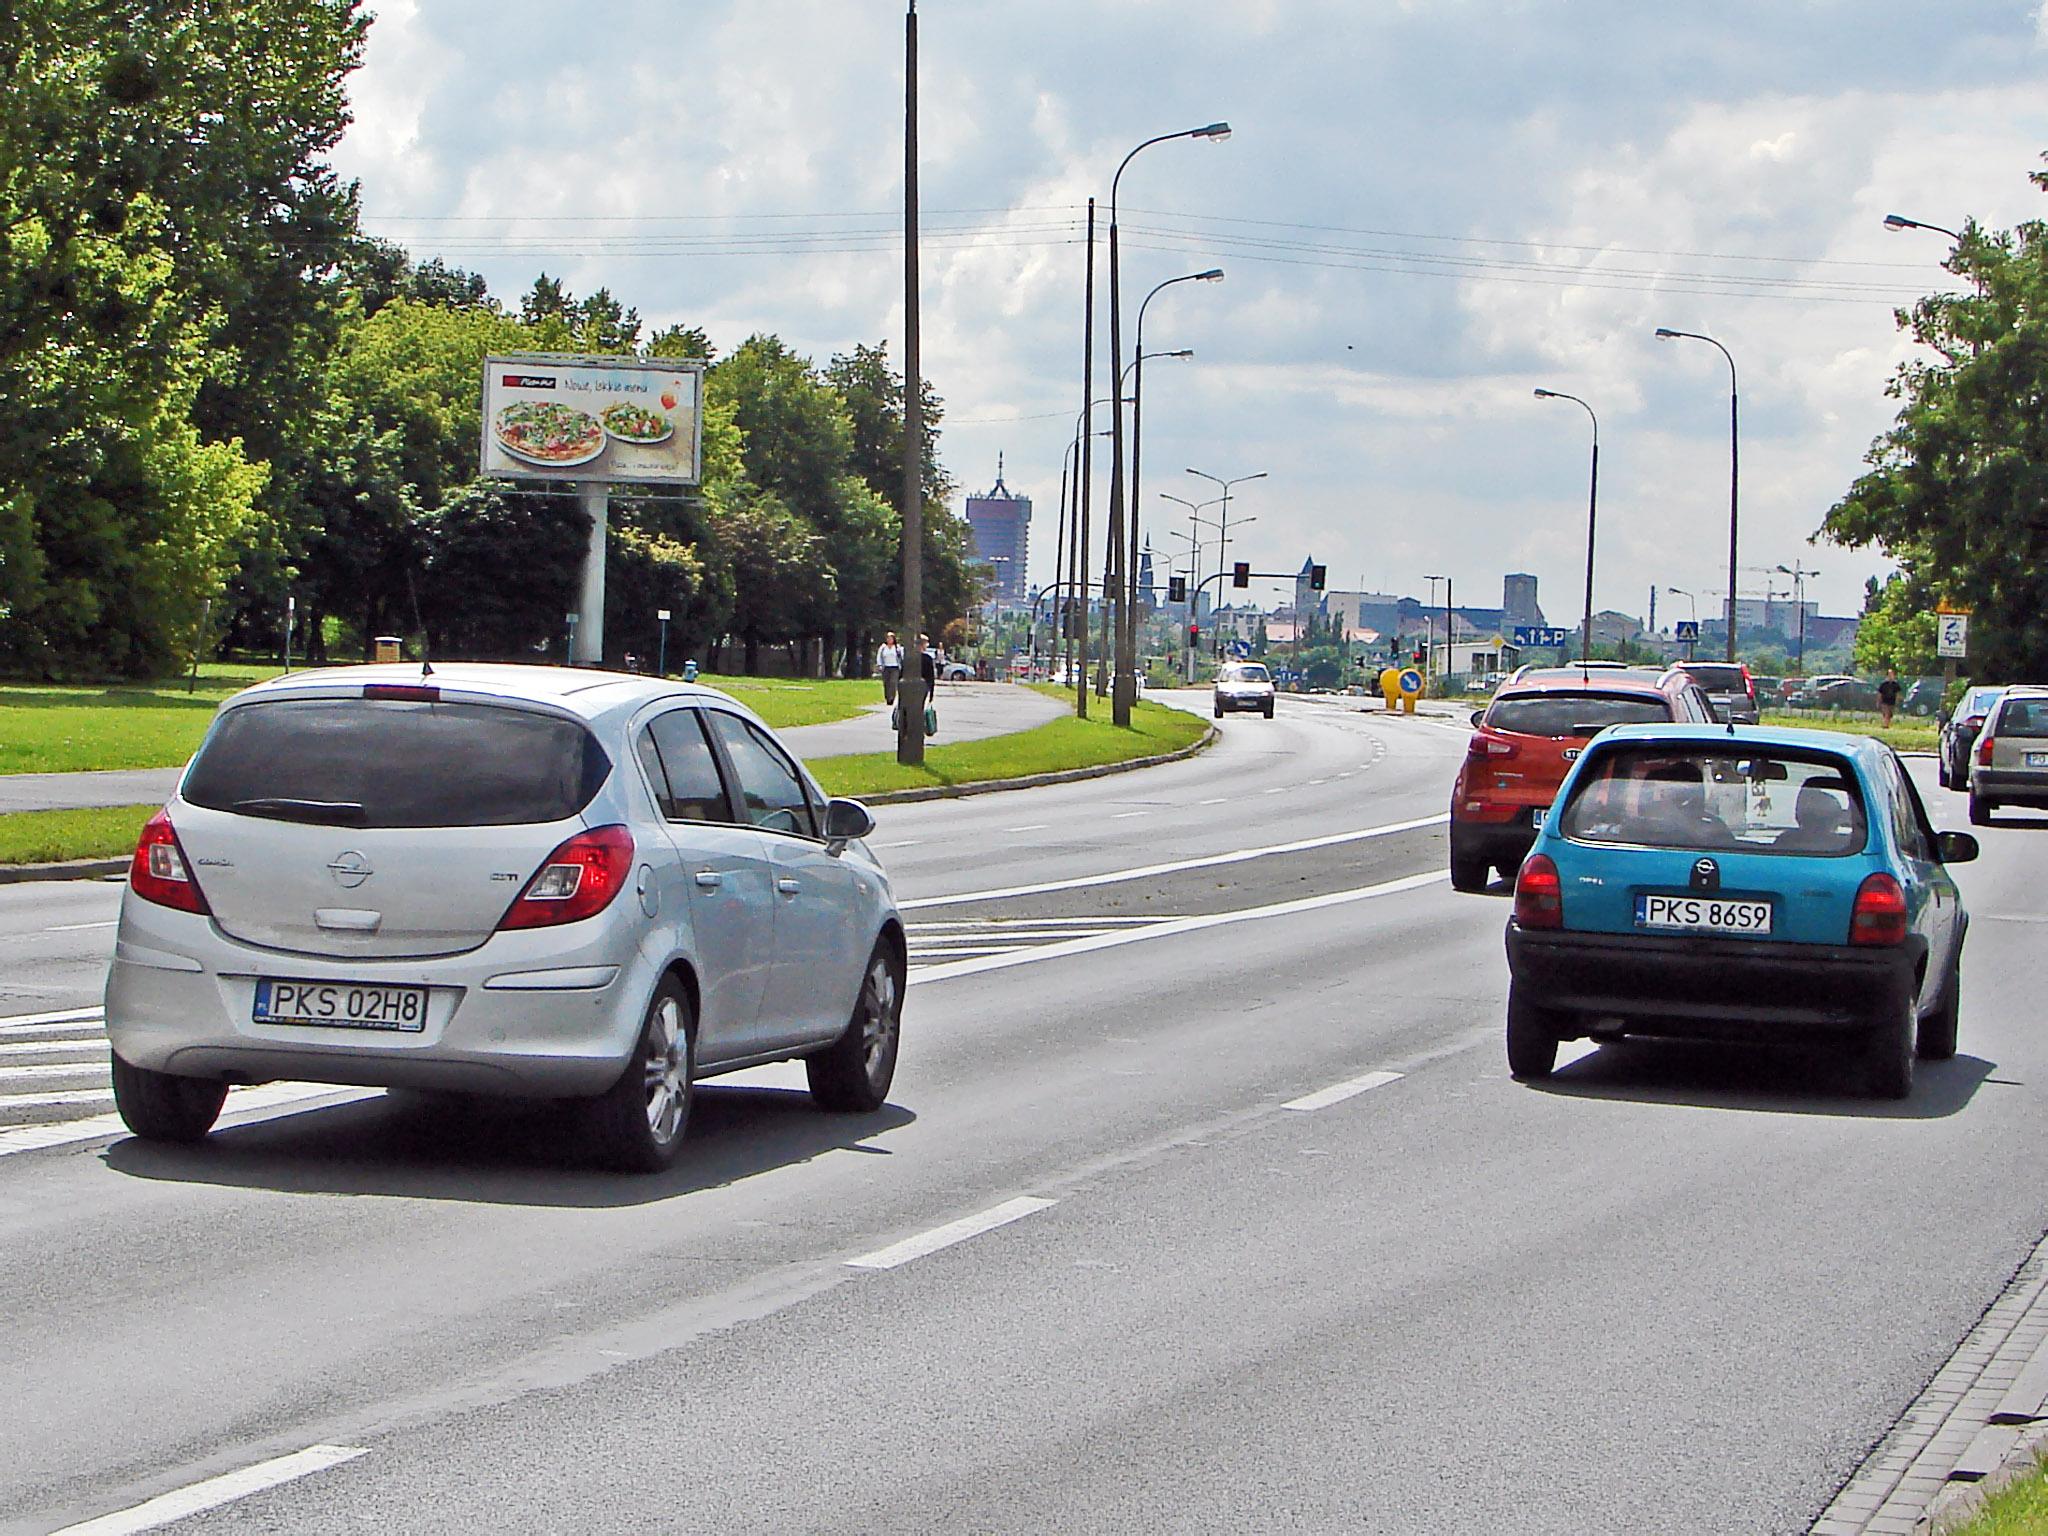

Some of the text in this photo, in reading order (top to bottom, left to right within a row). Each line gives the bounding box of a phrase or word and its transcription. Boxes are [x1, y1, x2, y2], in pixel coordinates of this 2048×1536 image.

[1554, 631, 1564, 644] P
[1649, 898, 1701, 923] PKS
[1708, 903, 1767, 929] 86S9
[274, 986, 419, 1022] PKS 02H8
